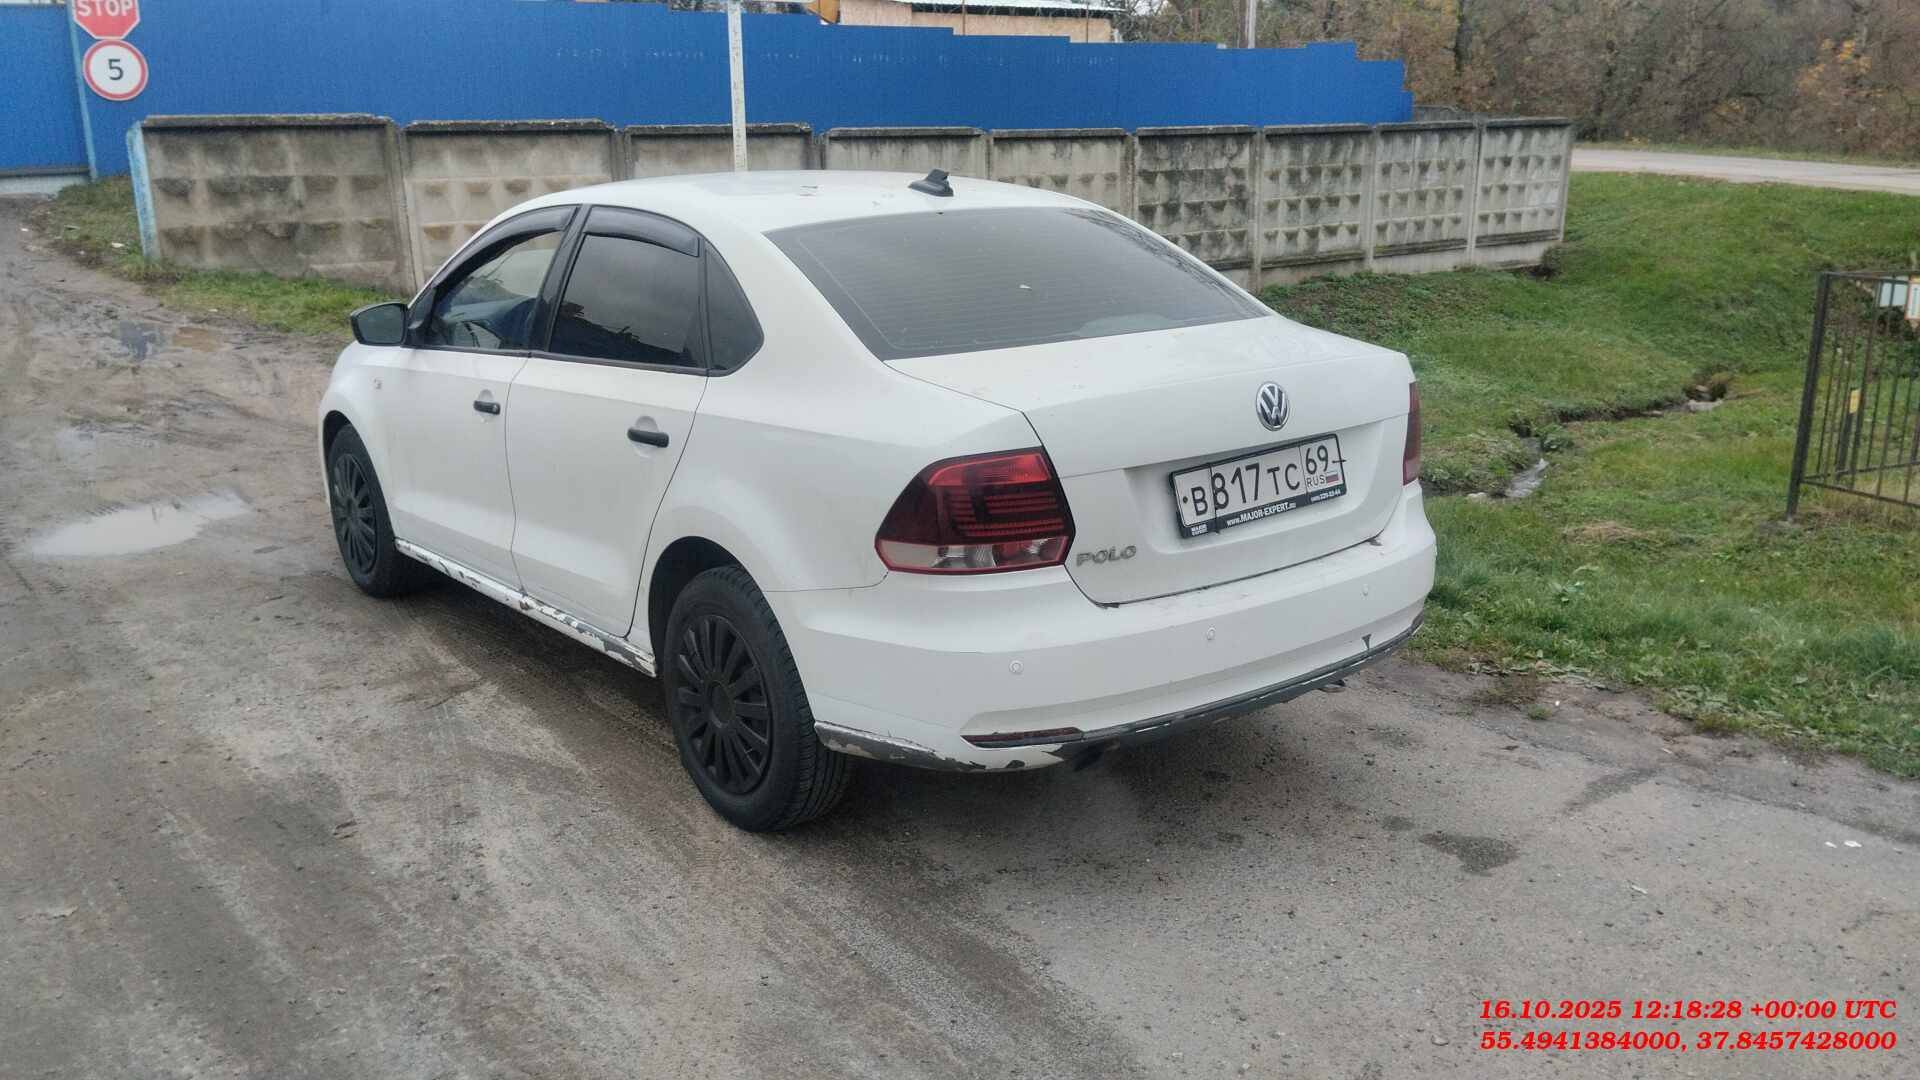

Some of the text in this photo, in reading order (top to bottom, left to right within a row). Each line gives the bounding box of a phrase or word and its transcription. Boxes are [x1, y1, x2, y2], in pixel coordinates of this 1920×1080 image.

[77, 0, 133, 16] STOP
[108, 58, 124, 80] 5
[1305, 444, 1329, 475] 69
[1306, 474, 1327, 488] RUS
[1227, 501, 1297, 527] www.MAJOR-EXPERT.
[1077, 545, 1137, 567] POLO
